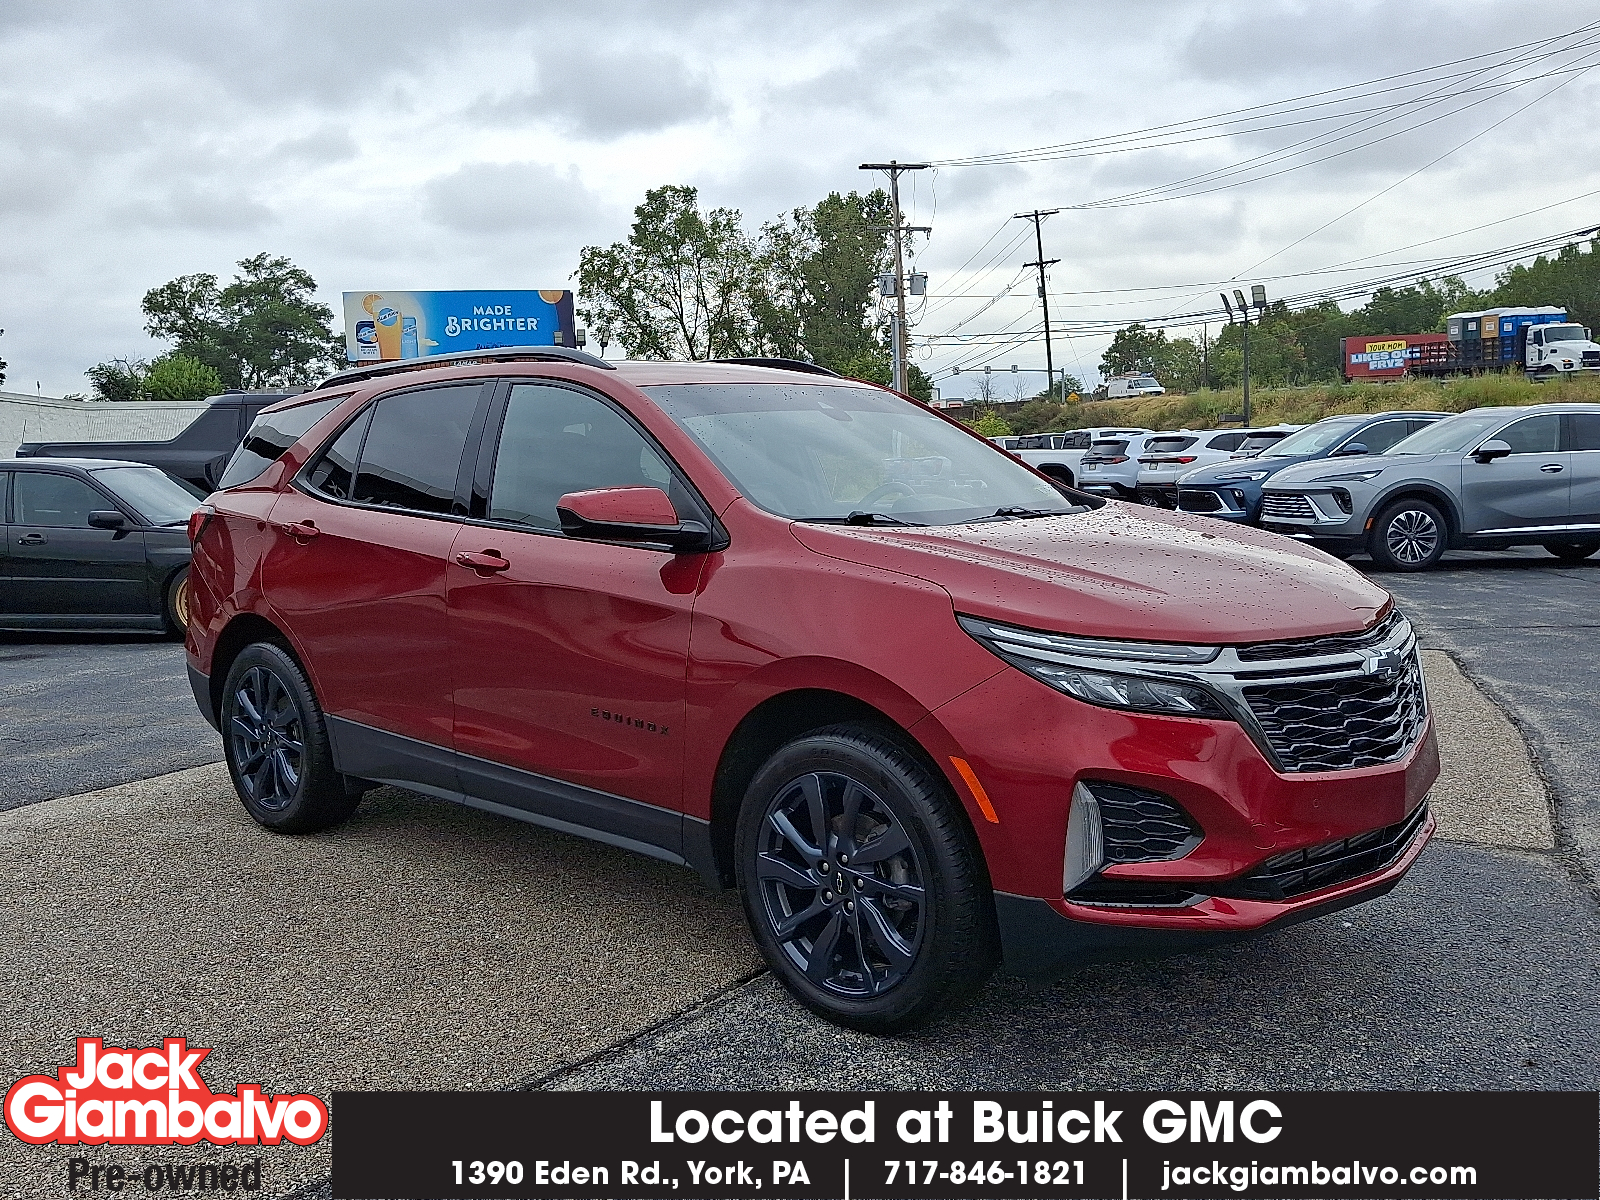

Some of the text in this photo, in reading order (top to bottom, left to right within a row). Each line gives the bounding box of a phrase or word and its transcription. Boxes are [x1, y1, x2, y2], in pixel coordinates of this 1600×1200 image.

[473, 305, 512, 316] MADE
[445, 316, 538, 337] BRIGHTER
[1369, 342, 1403, 352] YOUR MOM
[1351, 350, 1390, 364] LIKES
[590, 707, 669, 735] EQUINOX
